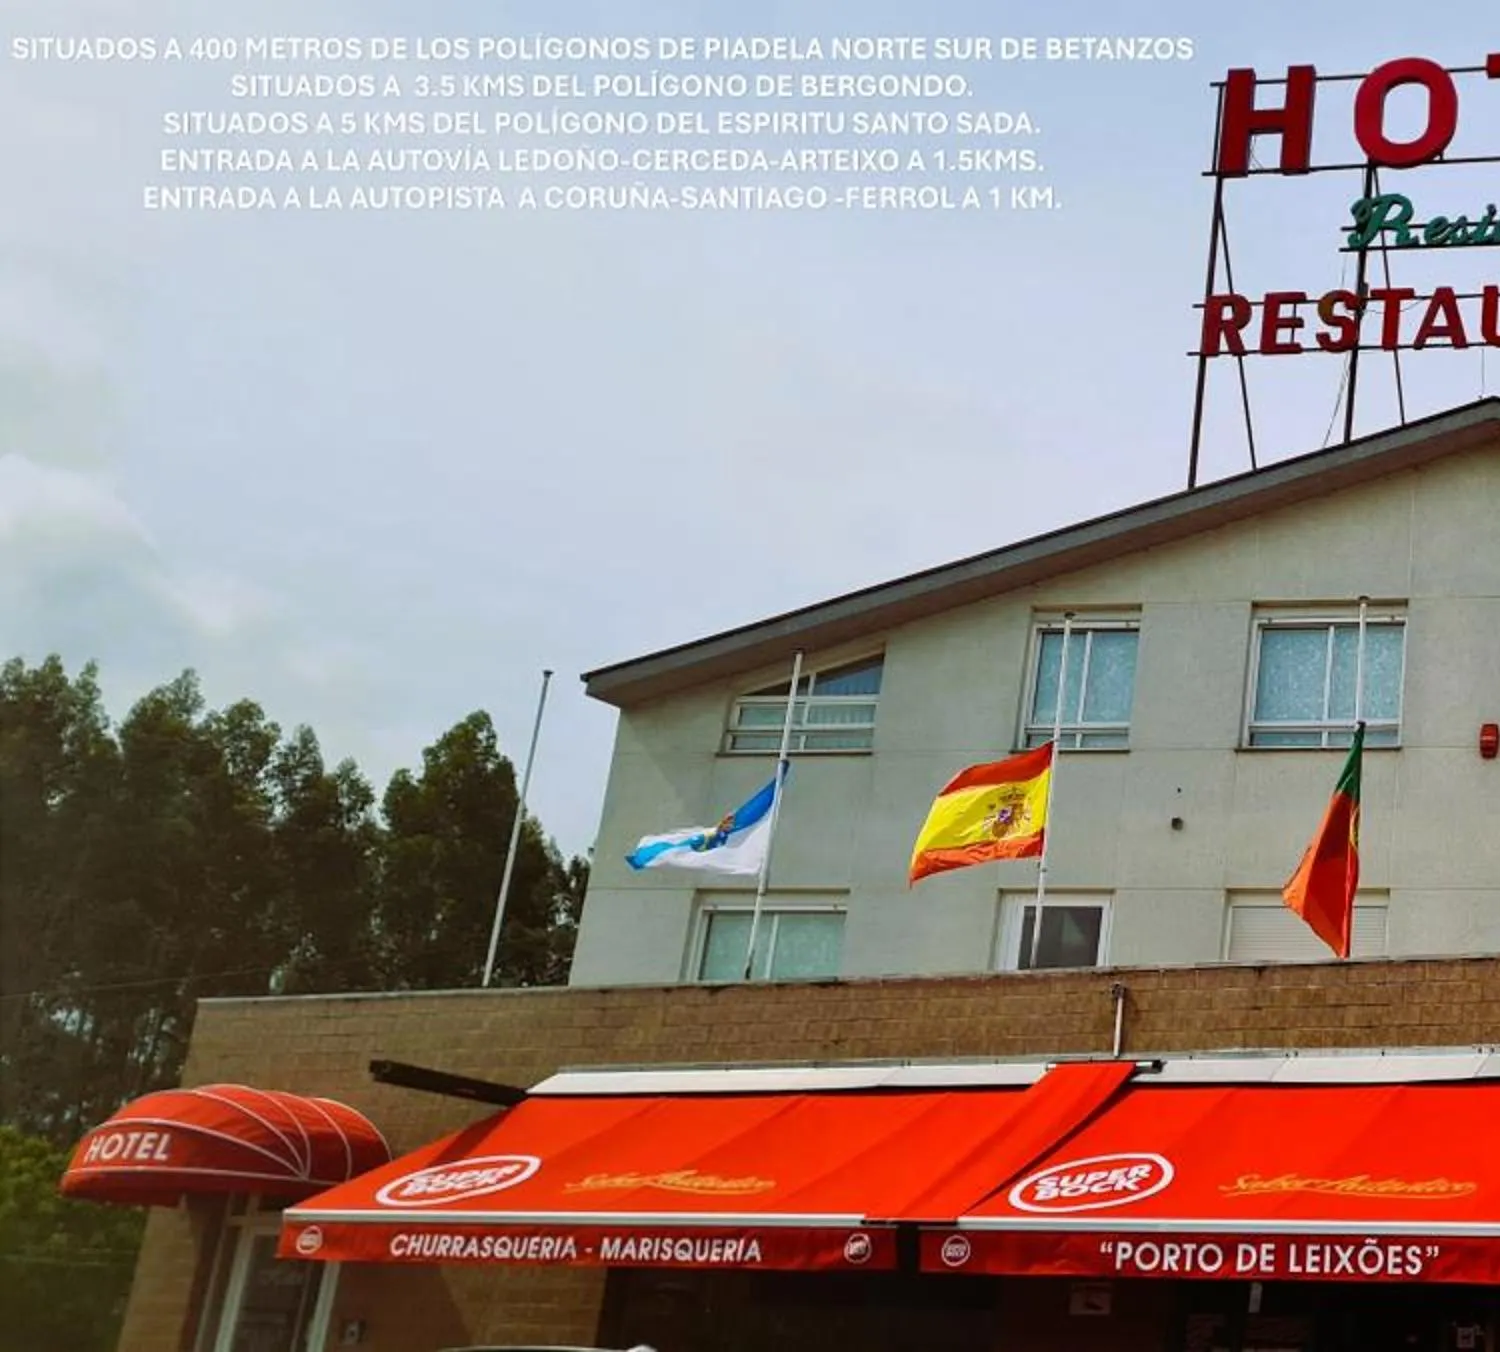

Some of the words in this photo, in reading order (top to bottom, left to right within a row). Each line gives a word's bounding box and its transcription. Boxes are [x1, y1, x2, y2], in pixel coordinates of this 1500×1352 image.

[84, 1131, 170, 1164] HOTEL
[1036, 1163, 1153, 1187] SUPER
[1034, 1177, 1141, 1201] BOCK
[389, 1234, 577, 1260] CHURRASQUERIA
[1236, 1244, 1275, 1273] DE
